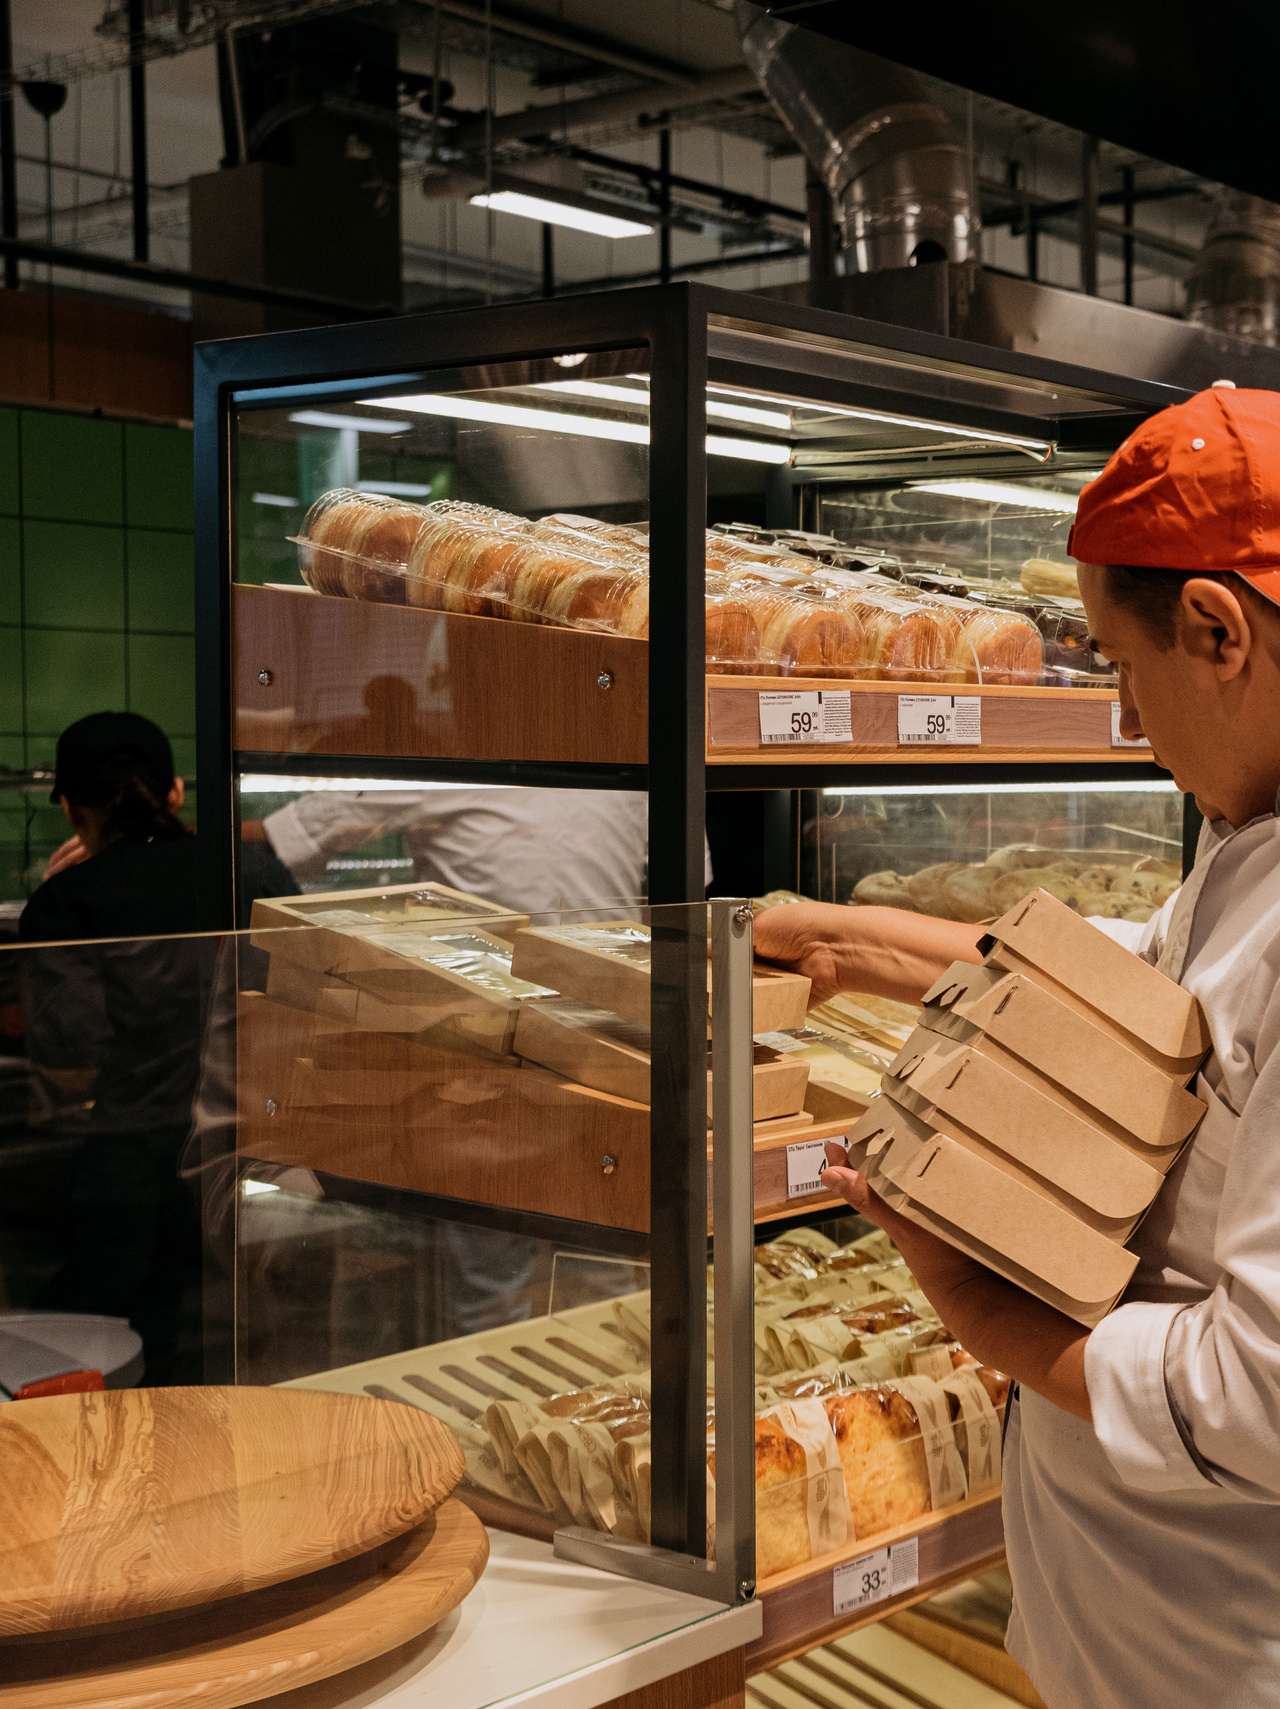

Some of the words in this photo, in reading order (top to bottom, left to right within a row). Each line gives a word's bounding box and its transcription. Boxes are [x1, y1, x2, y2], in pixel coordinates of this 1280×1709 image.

[791, 712, 812, 733] 59
[927, 714, 945, 734] 59
[861, 1570, 881, 1594] 33
